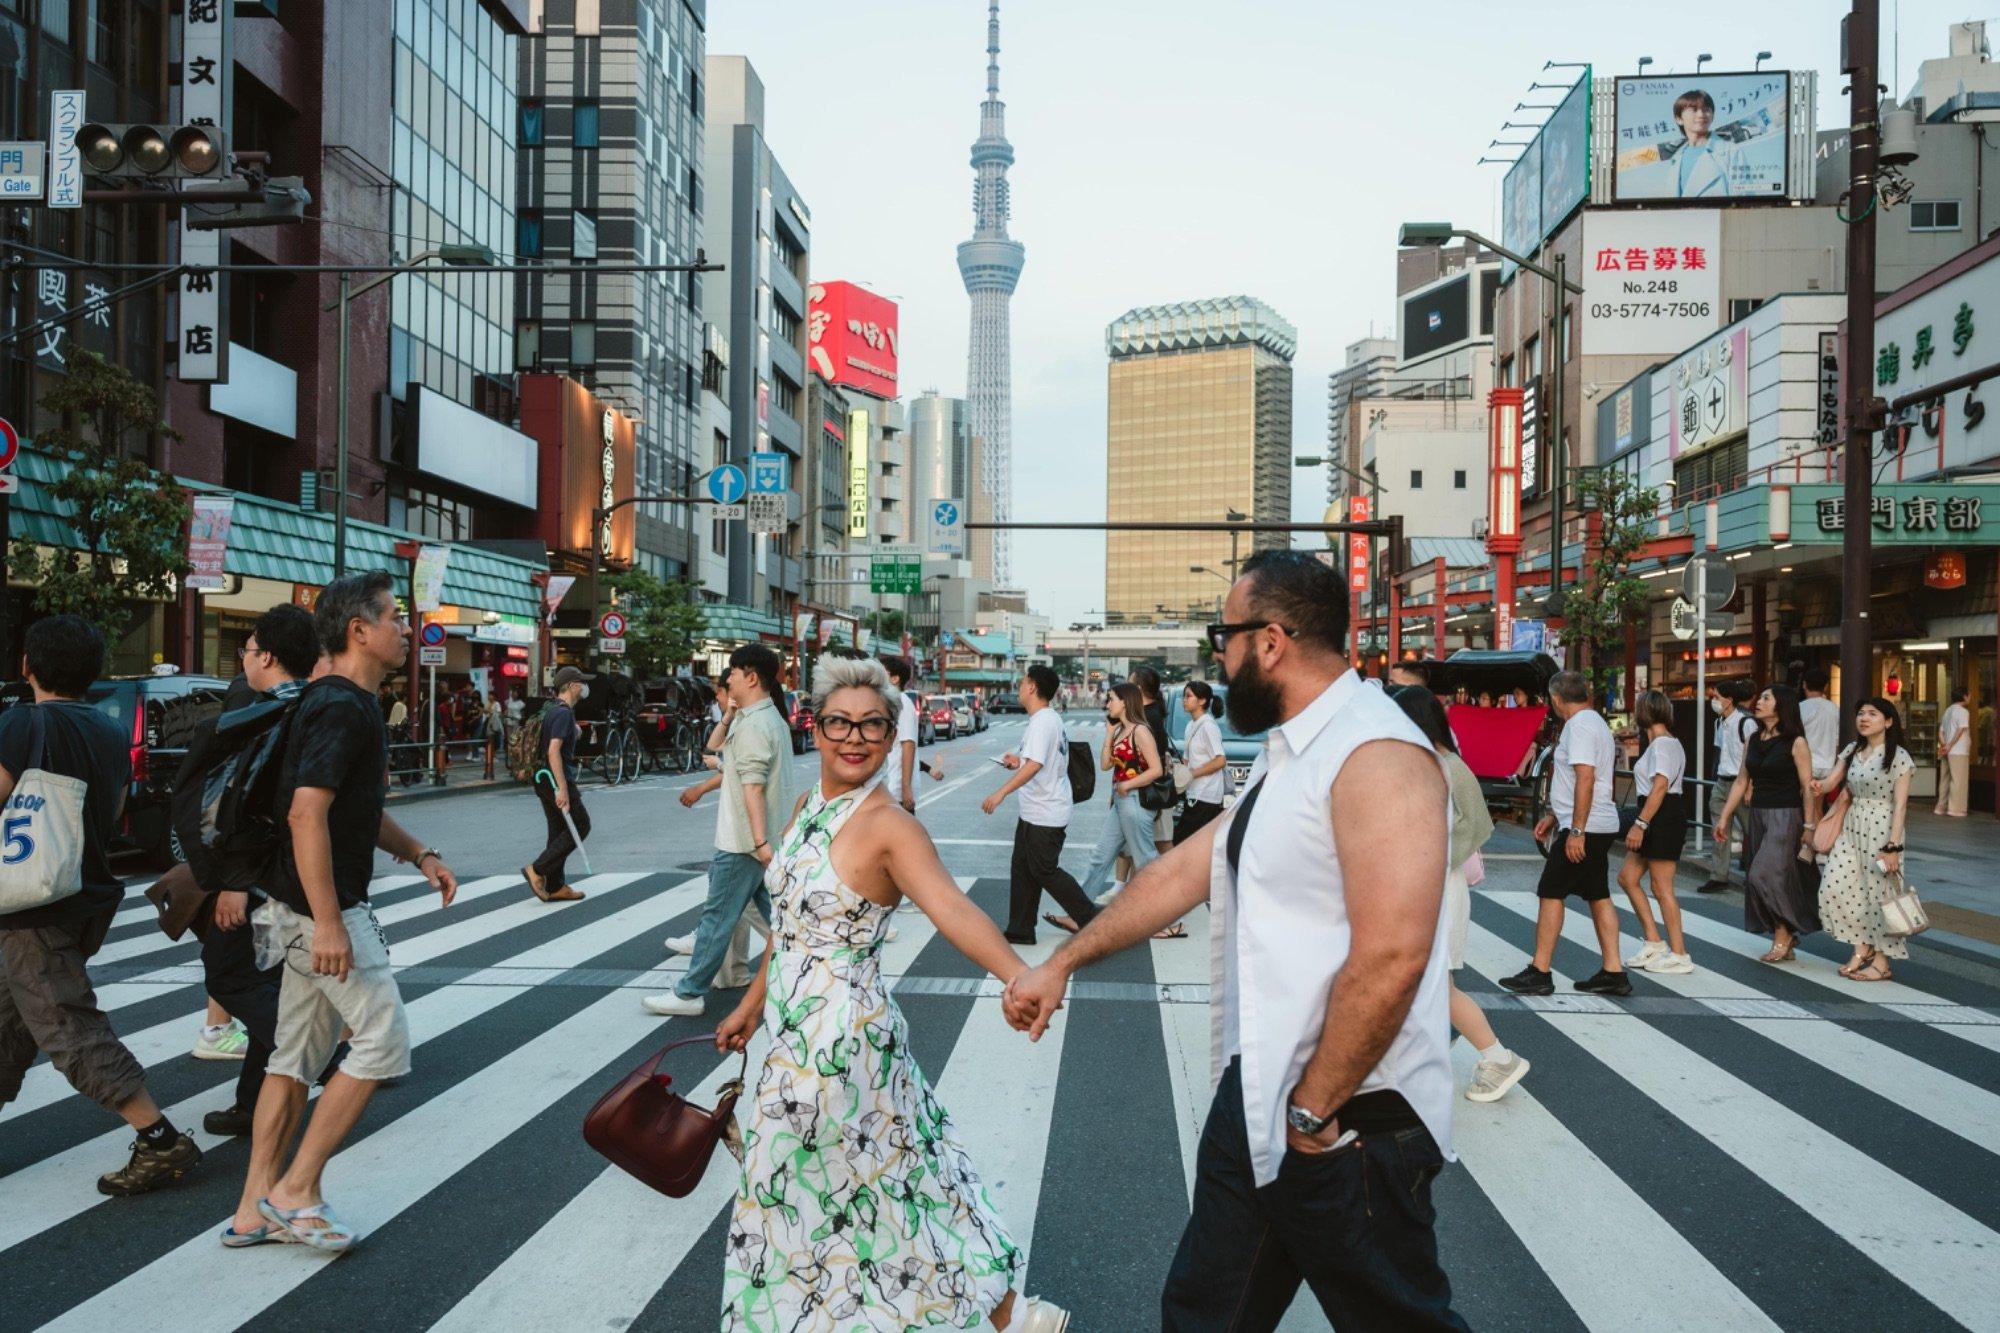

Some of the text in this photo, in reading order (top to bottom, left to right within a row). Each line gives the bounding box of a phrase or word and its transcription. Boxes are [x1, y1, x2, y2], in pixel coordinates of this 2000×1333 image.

[1640, 82, 1675, 91] TANAKA
[4, 179, 31, 191] Gate
[1595, 246, 1708, 271] 広告募集
[1590, 302, 1710, 318] 03-5774-7506
[1822, 355, 1838, 443] 亀十もなか
[1818, 495, 1982, 531] 雷門東部
[1352, 503, 1366, 587] 丸不動産
[2, 815, 35, 865] 5
